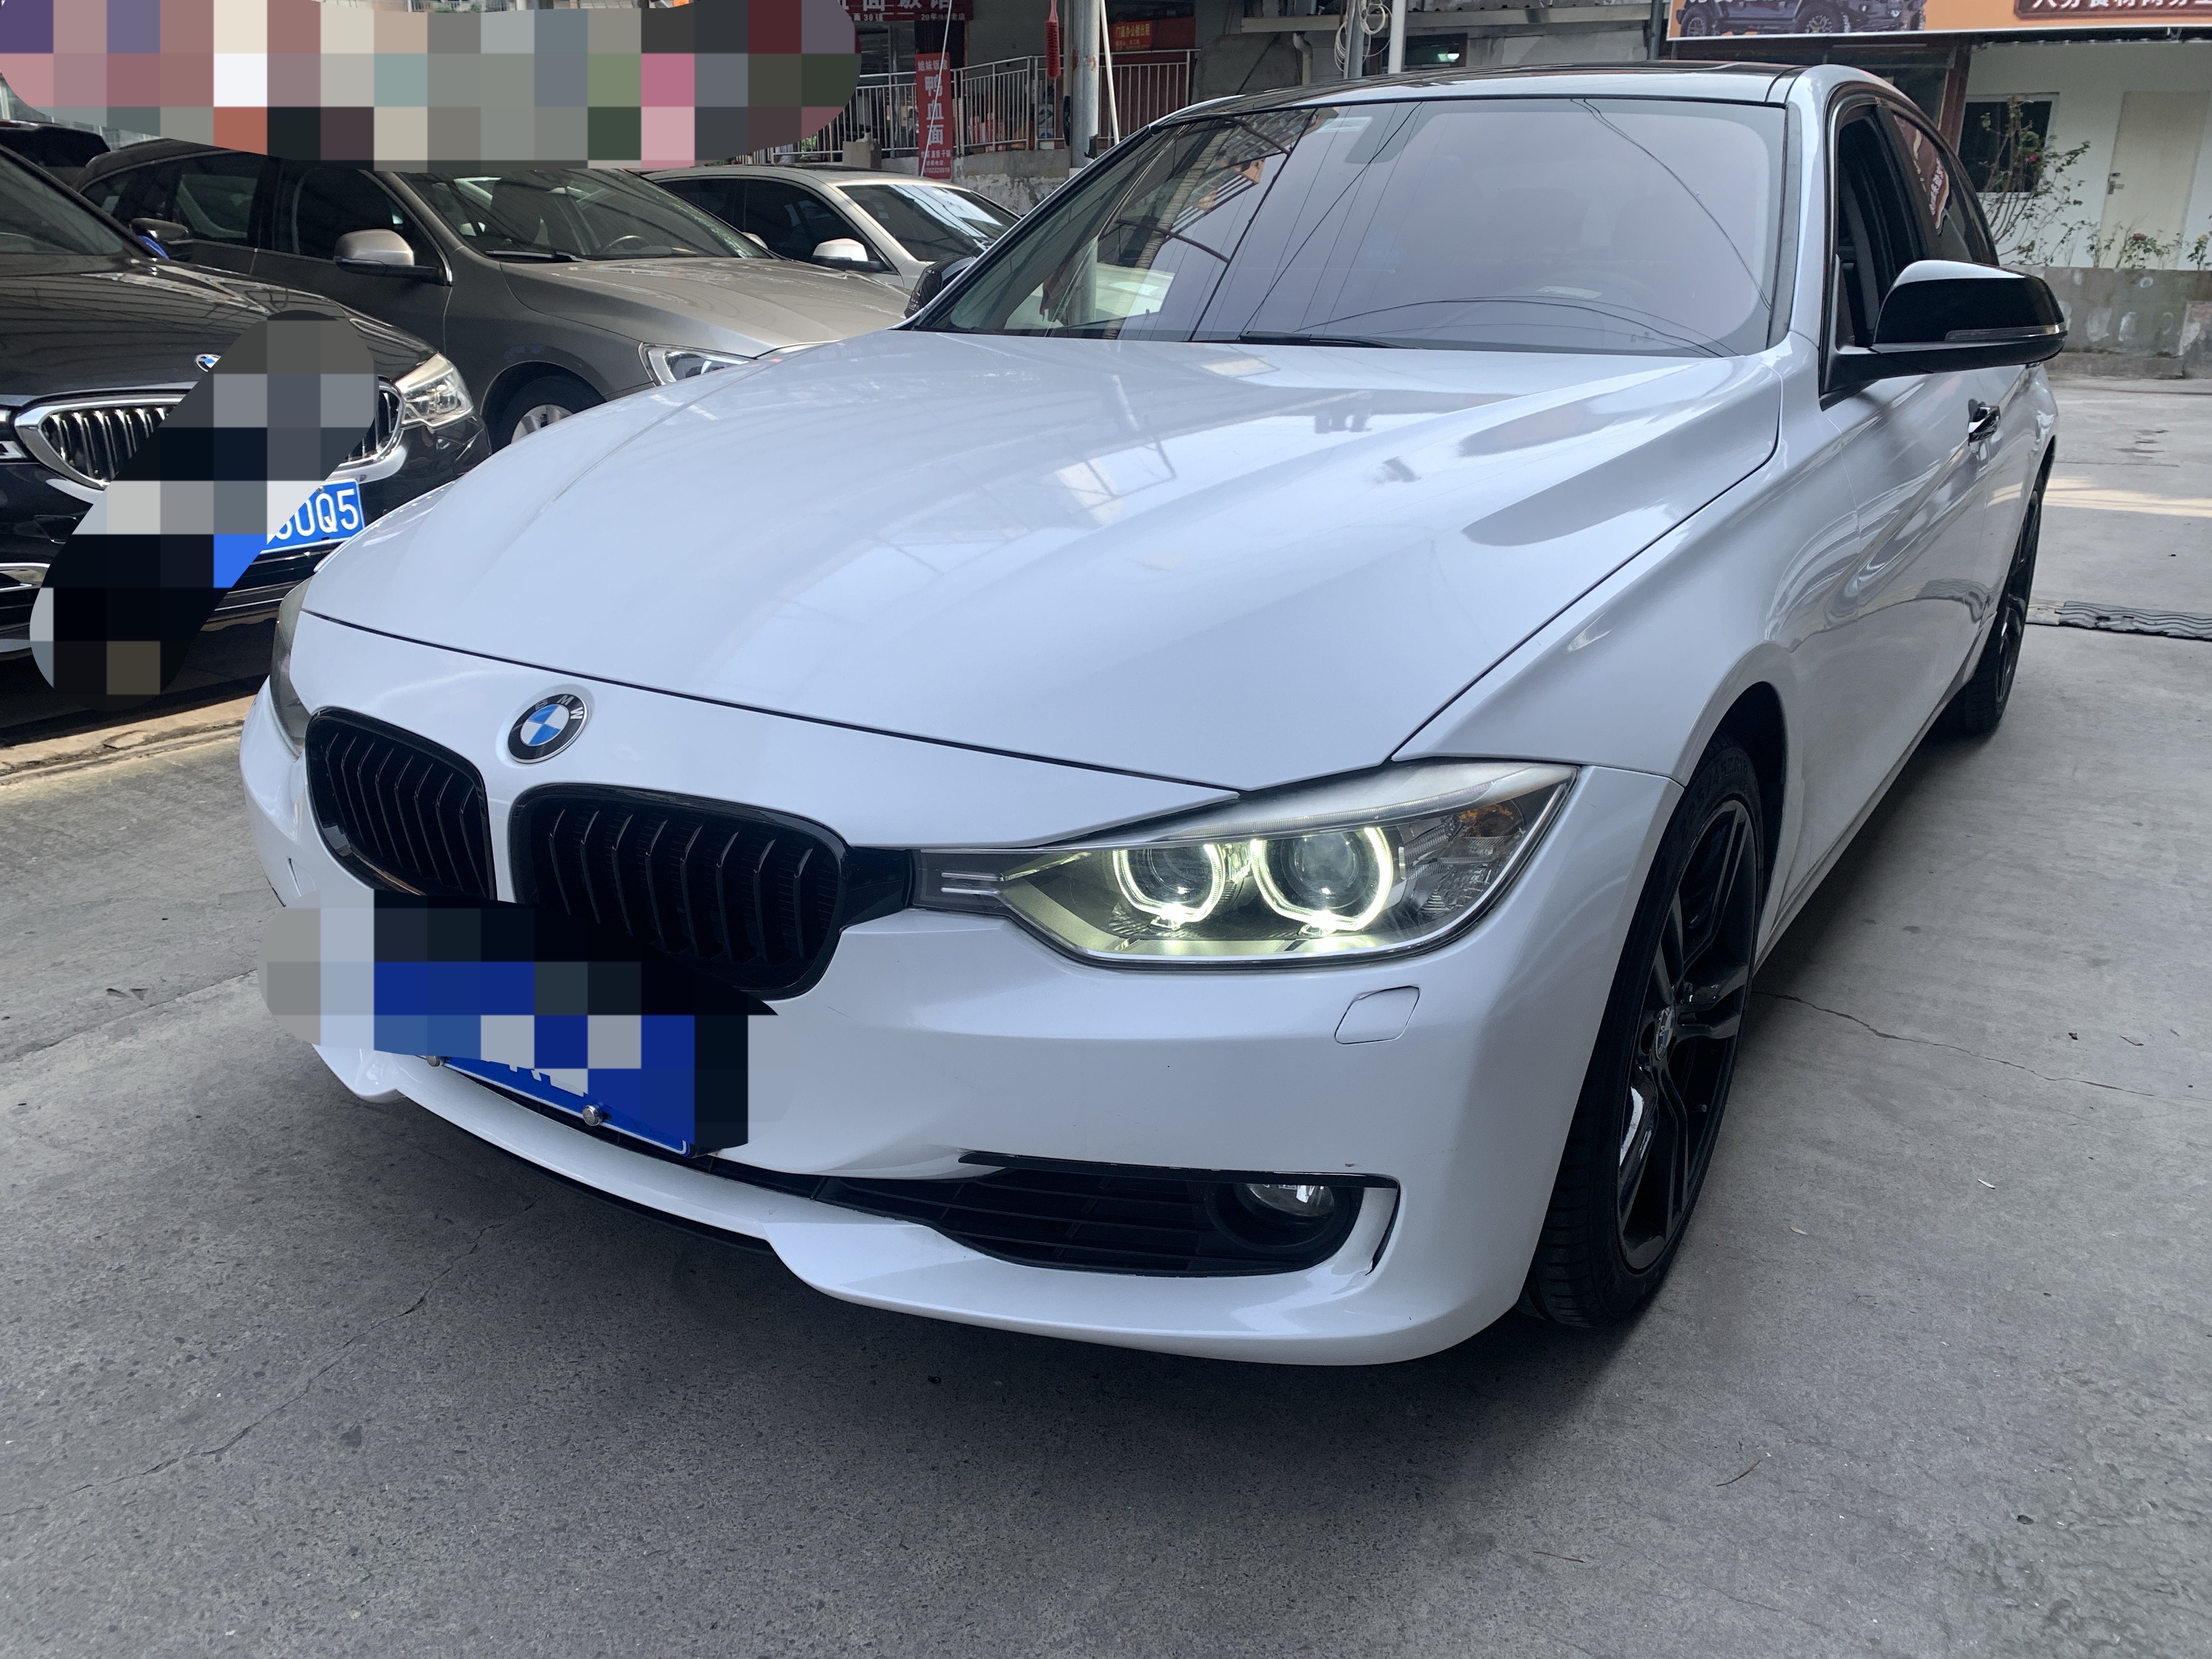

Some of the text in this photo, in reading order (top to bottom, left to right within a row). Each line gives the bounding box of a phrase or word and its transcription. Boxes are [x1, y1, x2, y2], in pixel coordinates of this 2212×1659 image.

[924, 74, 944, 145] 鸭血面
[535, 695, 583, 719] BMW
[1658, 1007, 1670, 1054] BMW
